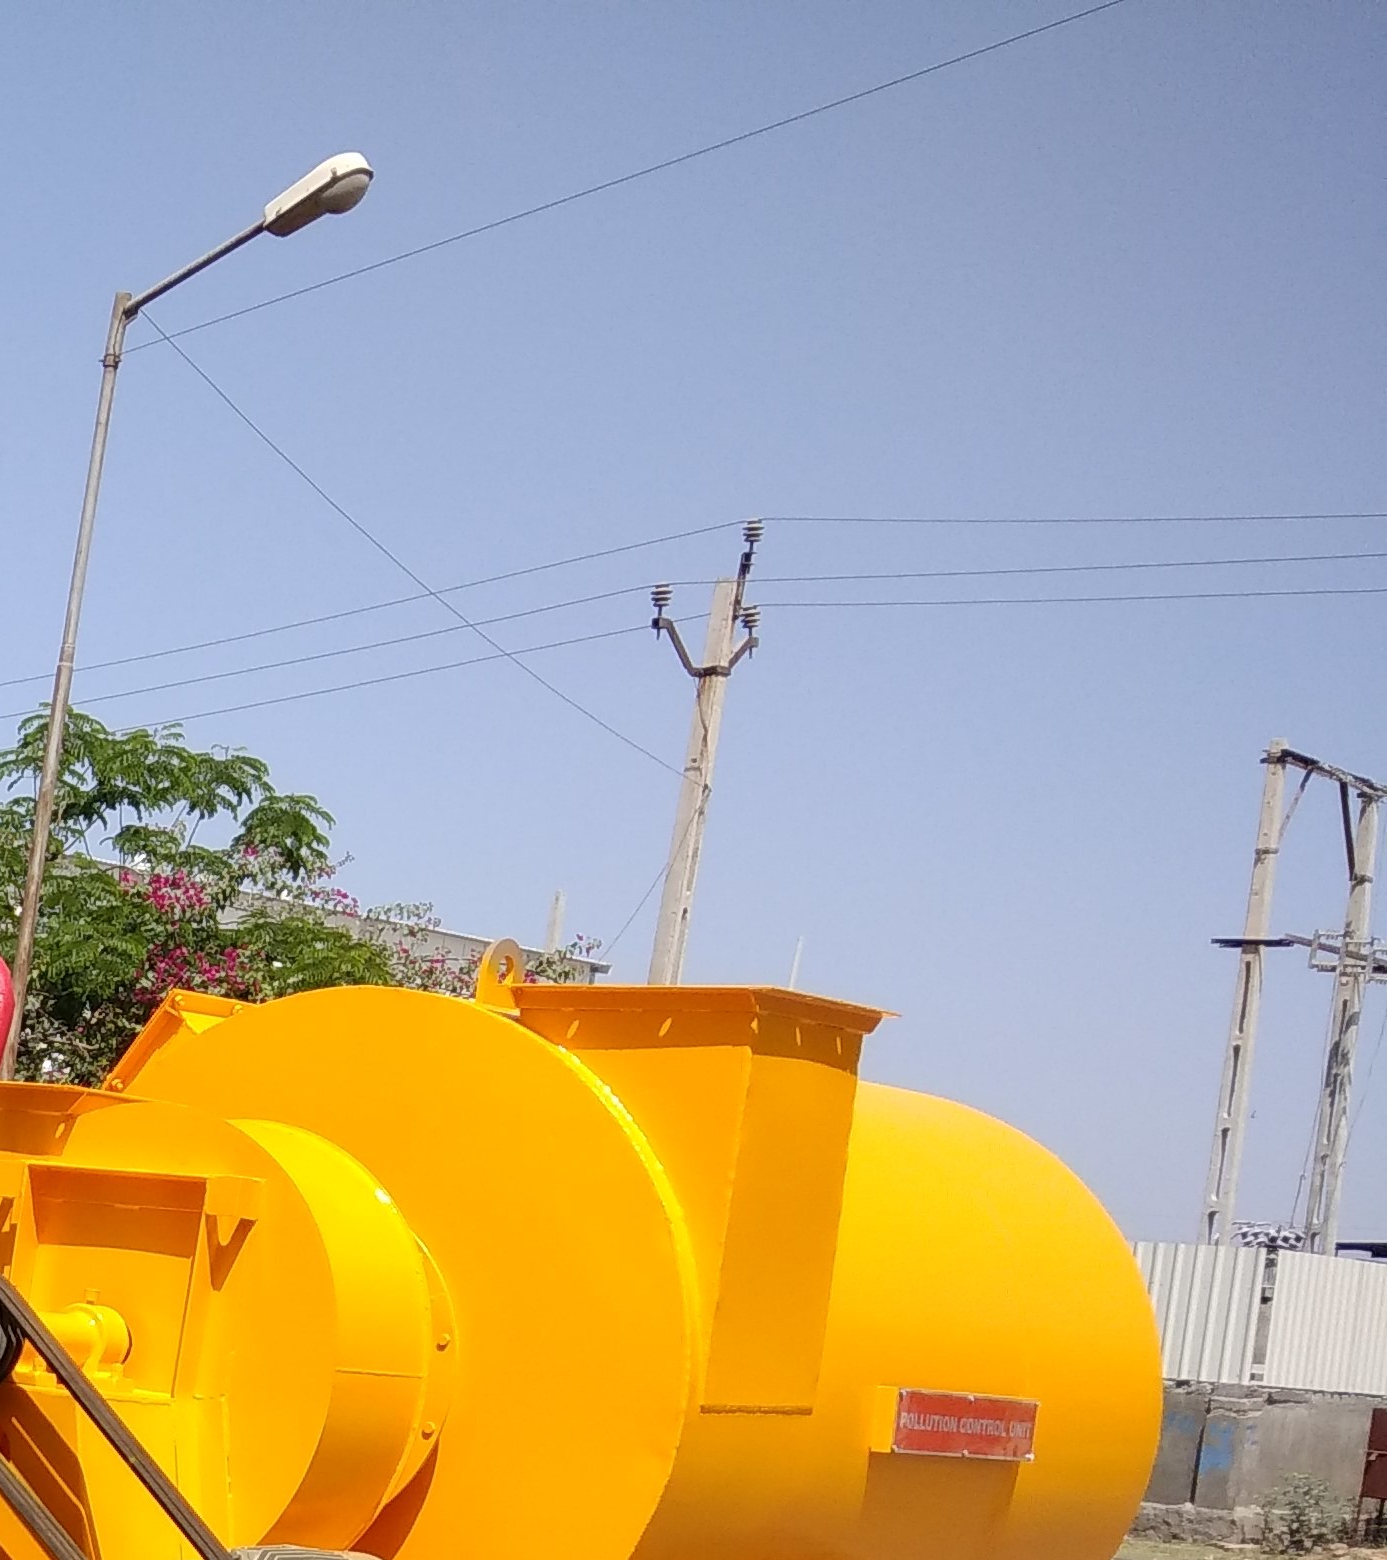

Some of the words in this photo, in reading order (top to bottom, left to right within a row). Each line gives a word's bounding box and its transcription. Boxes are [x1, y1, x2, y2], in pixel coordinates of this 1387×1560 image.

[899, 1412, 959, 1434] POLLUTION
[959, 1417, 1007, 1437] CONTROL
[1009, 1420, 1032, 1439] UNIT
